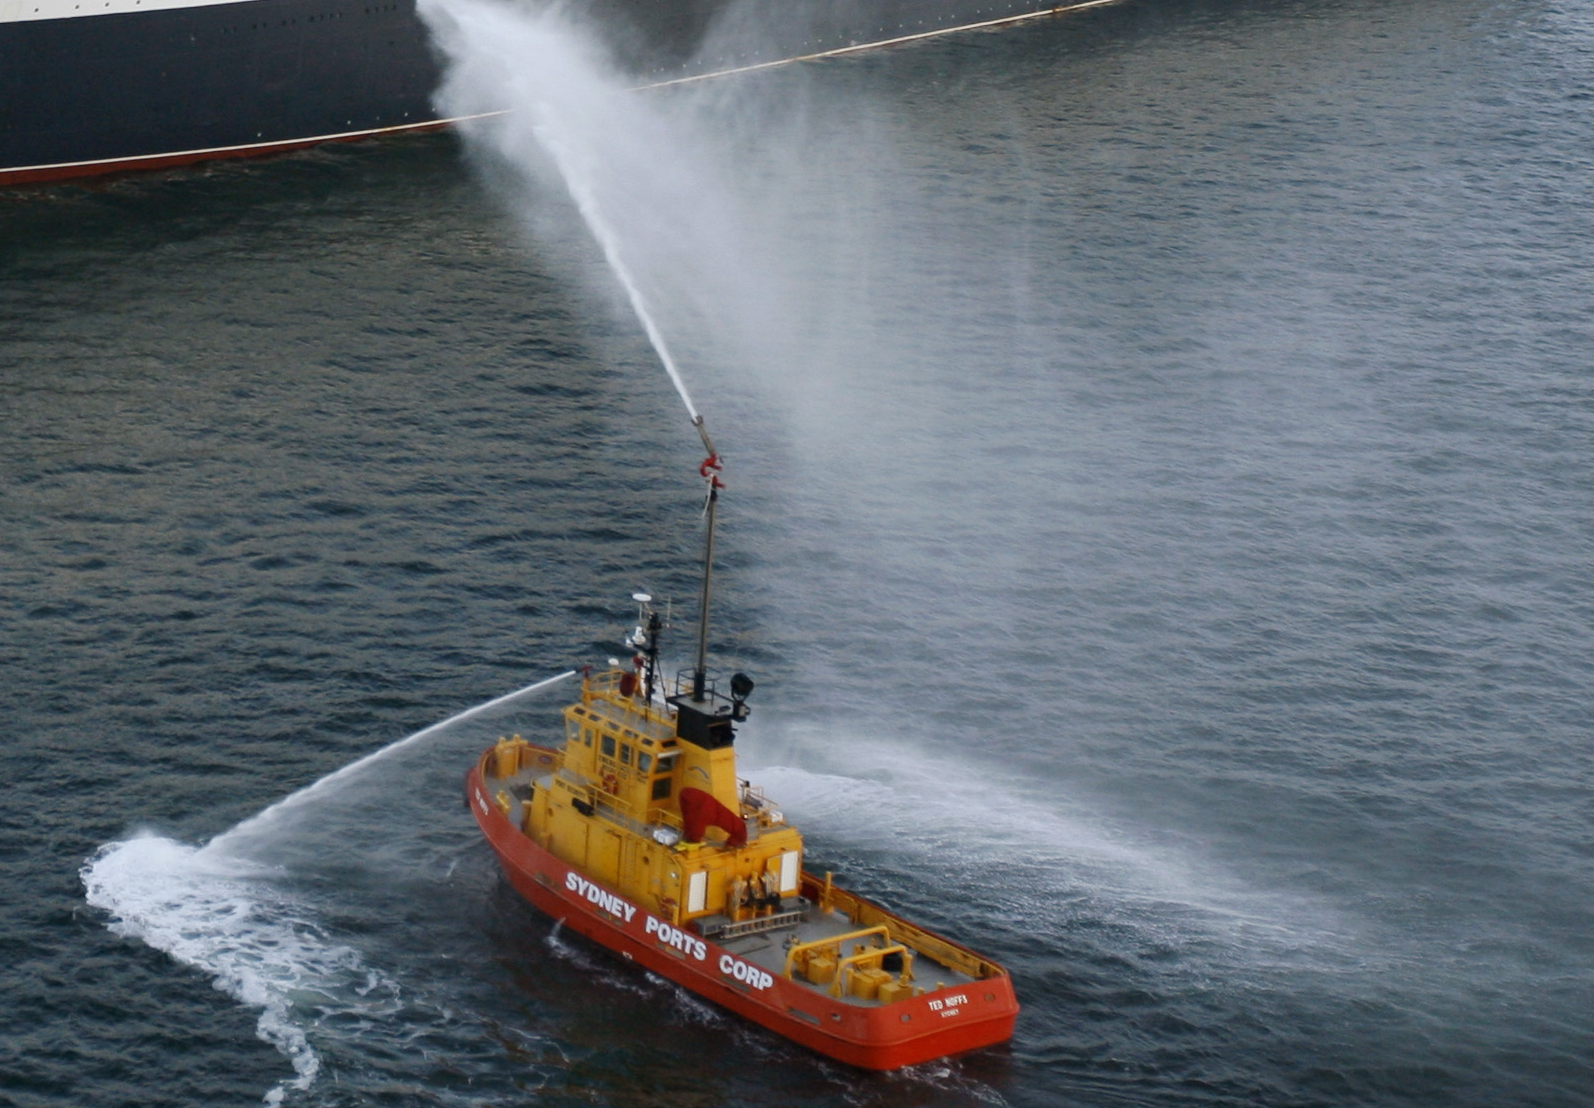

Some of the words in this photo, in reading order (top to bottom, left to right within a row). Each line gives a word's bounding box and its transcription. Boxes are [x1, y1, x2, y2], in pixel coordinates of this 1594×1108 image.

[565, 871, 637, 923] SYDNEY
[645, 915, 707, 961] PORTS
[718, 954, 774, 991] CORP
[928, 1000, 943, 1011] TED
